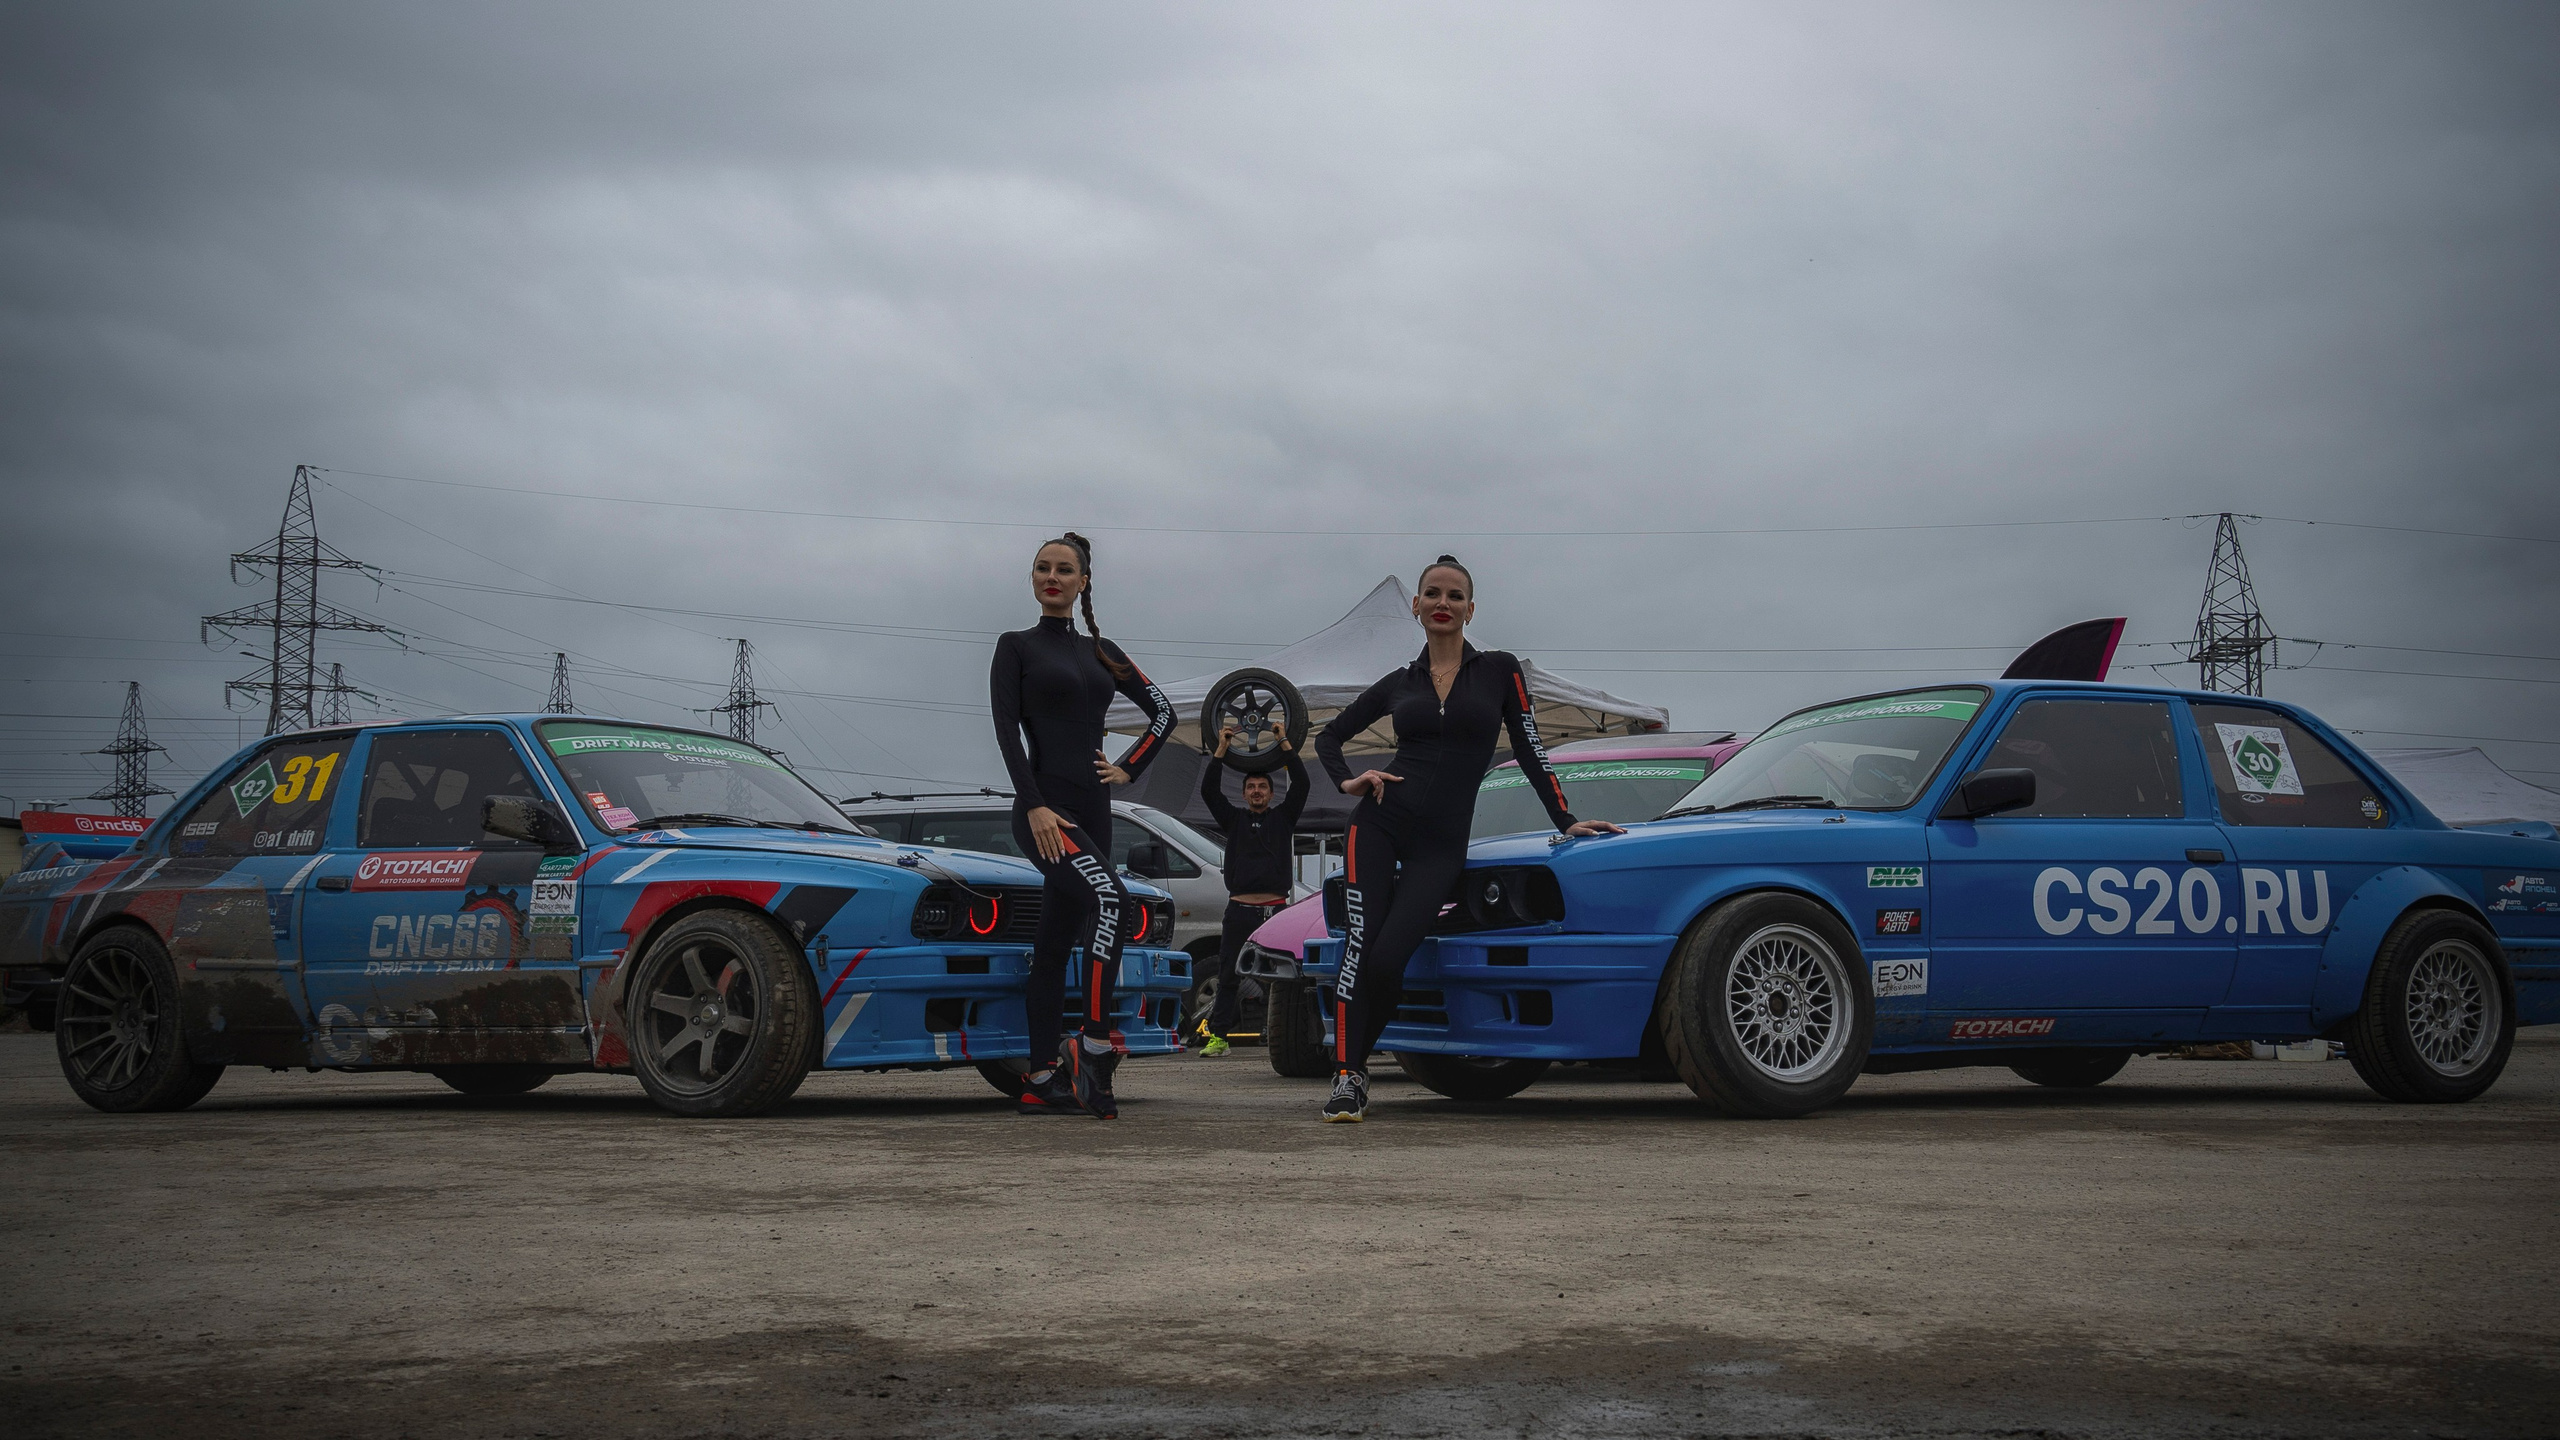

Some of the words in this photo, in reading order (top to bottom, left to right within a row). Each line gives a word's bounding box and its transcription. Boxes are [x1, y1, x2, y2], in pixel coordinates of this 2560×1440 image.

[1823, 703, 1944, 723] CHAMPIONSHIP
[1521, 713, 1554, 772] РОКЕАВТО
[571, 739, 620, 750] DRIFT
[625, 738, 672, 750] WARS
[676, 743, 780, 769] CHAMPIONSHIP
[2244, 752, 2274, 772] 30
[272, 753, 340, 804] 31
[1566, 769, 1681, 780] CHAMPIONSHIP
[241, 780, 267, 798] 82
[94, 820, 144, 832] cnc66
[383, 859, 469, 875] TOTACHI
[1869, 867, 1922, 887] DWC
[2032, 867, 2331, 935] CS20.RU
[369, 914, 501, 958] CNC66
[1883, 921, 1910, 933] АВТО
[364, 961, 428, 977] DRIFT
[434, 960, 495, 976] TEAM
[1953, 1019, 2055, 1035] TOTACHI
